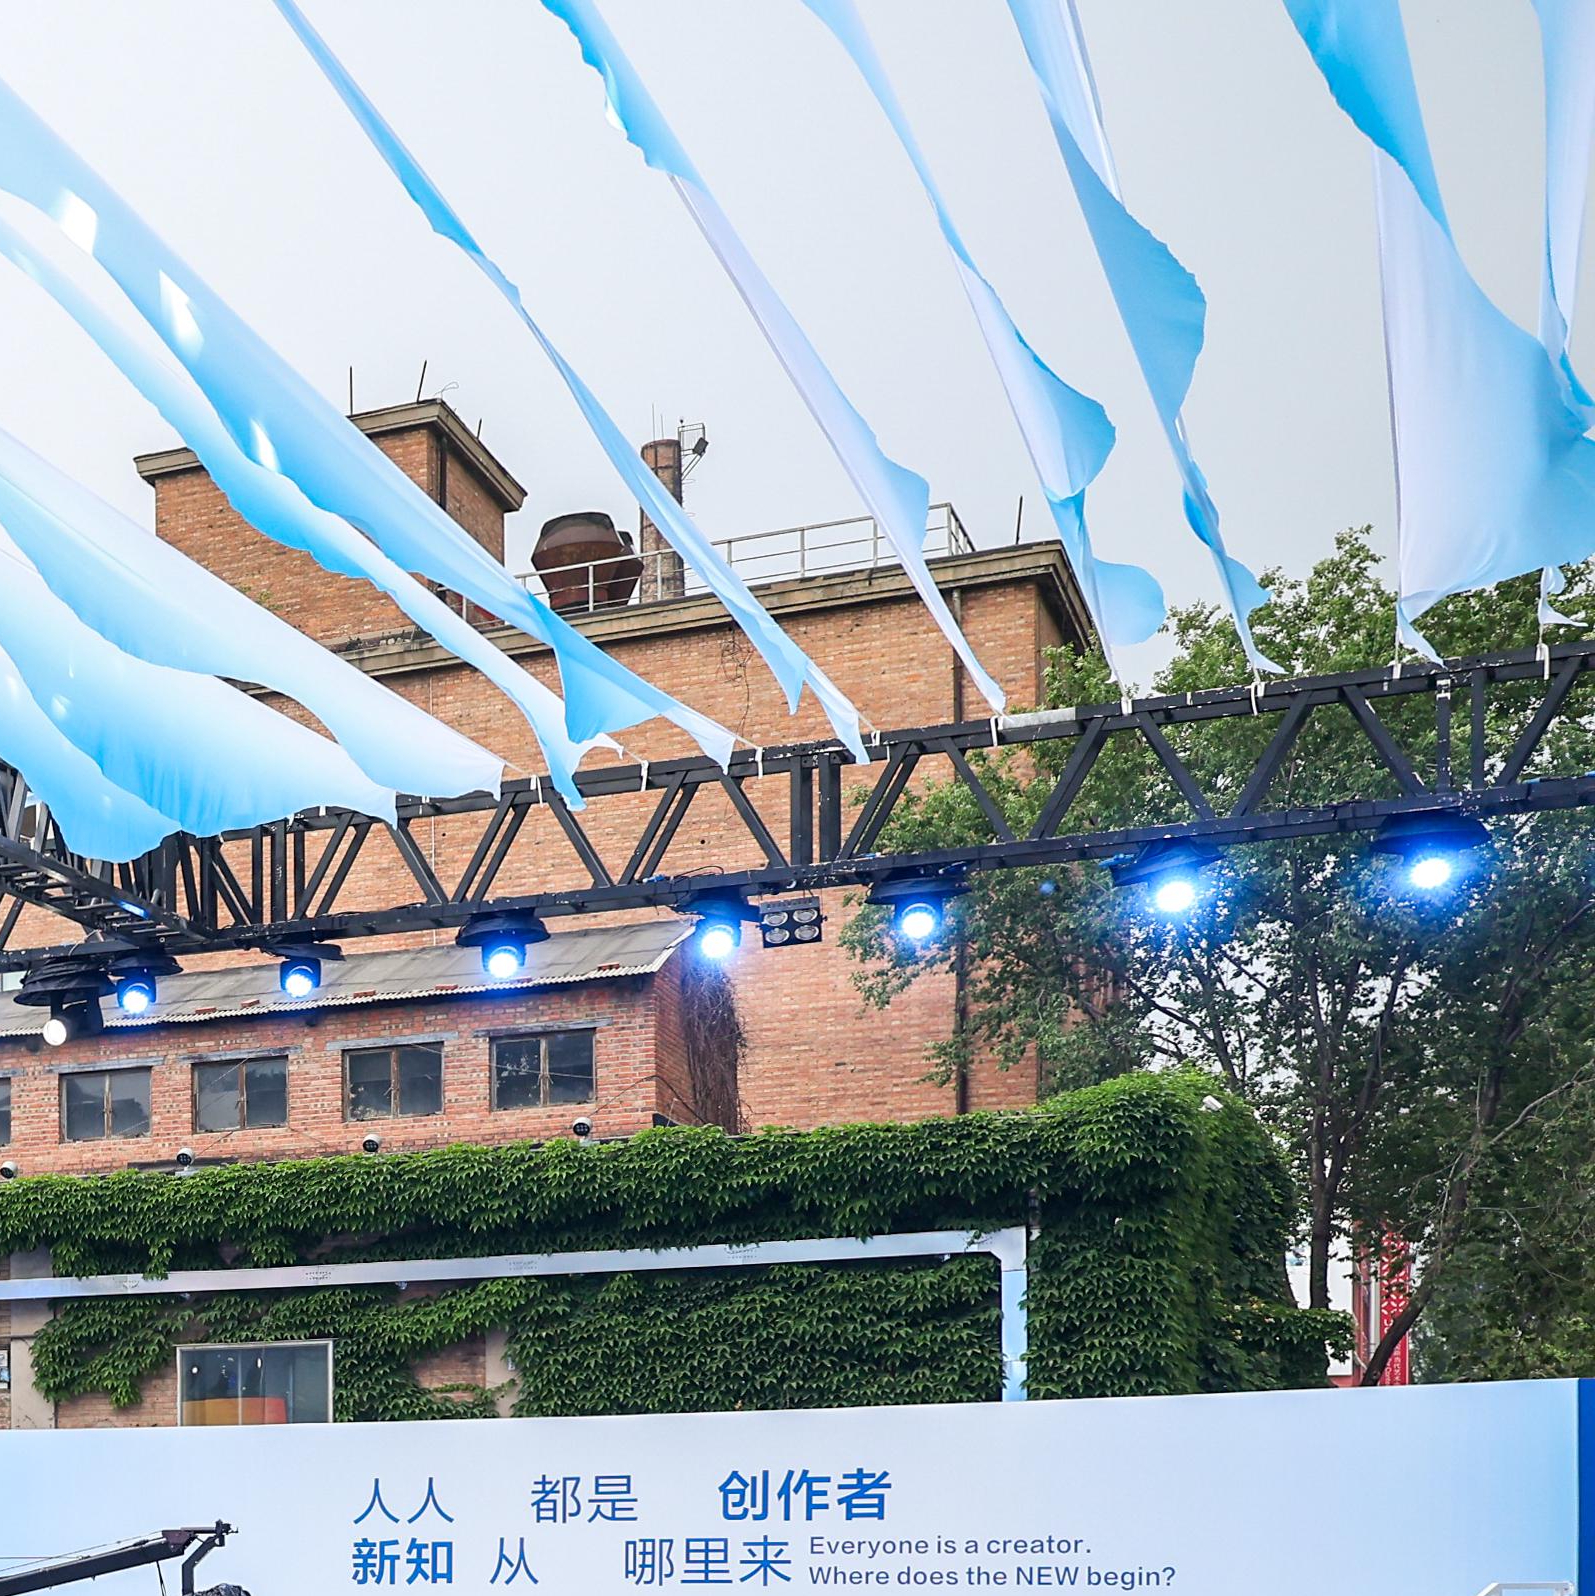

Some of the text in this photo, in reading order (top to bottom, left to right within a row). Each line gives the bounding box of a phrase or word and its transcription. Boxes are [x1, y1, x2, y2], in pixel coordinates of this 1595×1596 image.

[352, 1467, 892, 1524] 人人 都是 创作者
[351, 1534, 793, 1586] 新知 从 哪里来
[810, 1535, 1092, 1559] Everyone is a creator.
[809, 1566, 1176, 1591] Where does the NEW begin?
